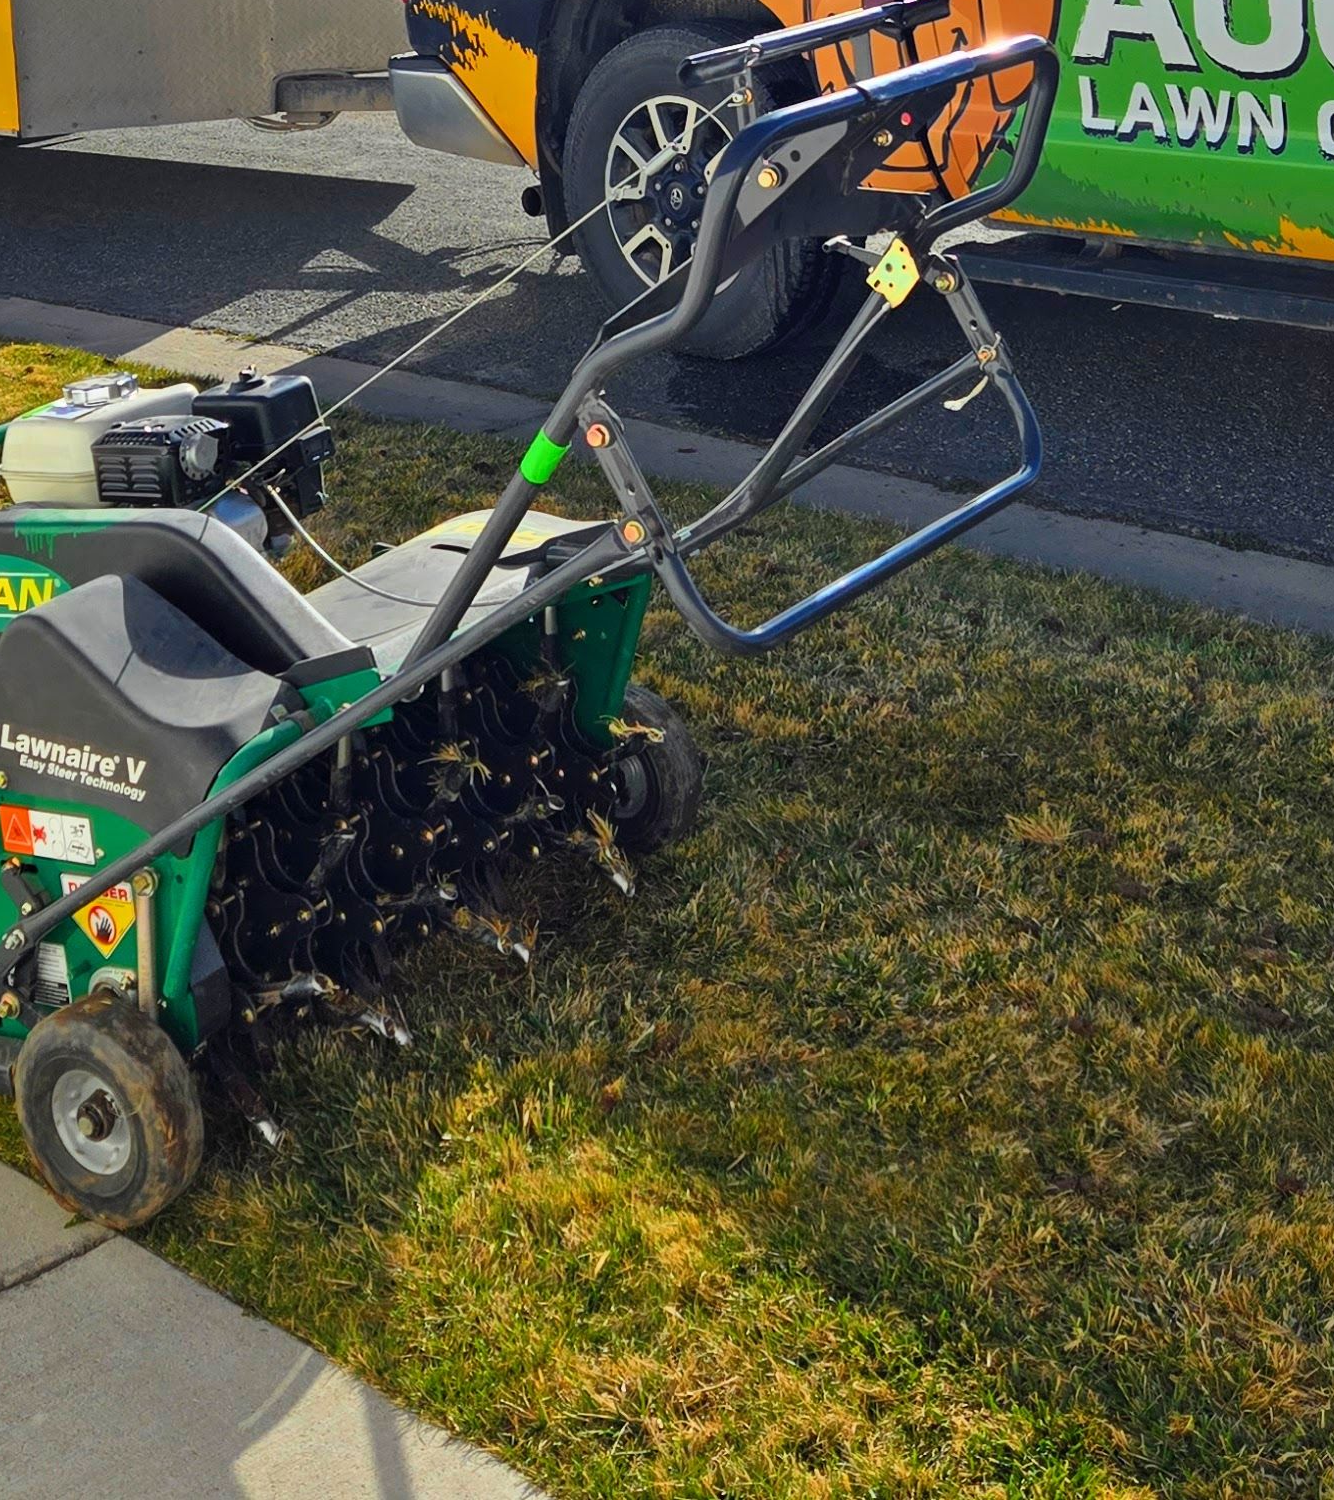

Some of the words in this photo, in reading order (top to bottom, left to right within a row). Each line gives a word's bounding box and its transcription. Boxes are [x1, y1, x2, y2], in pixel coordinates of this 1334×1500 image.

[1077, 74, 1286, 155] LAWN
[0, 723, 116, 777] Lawnaire
[126, 756, 147, 784] V
[19, 753, 46, 775] Easy
[47, 763, 78, 782] Steer
[80, 770, 147, 803] Technology
